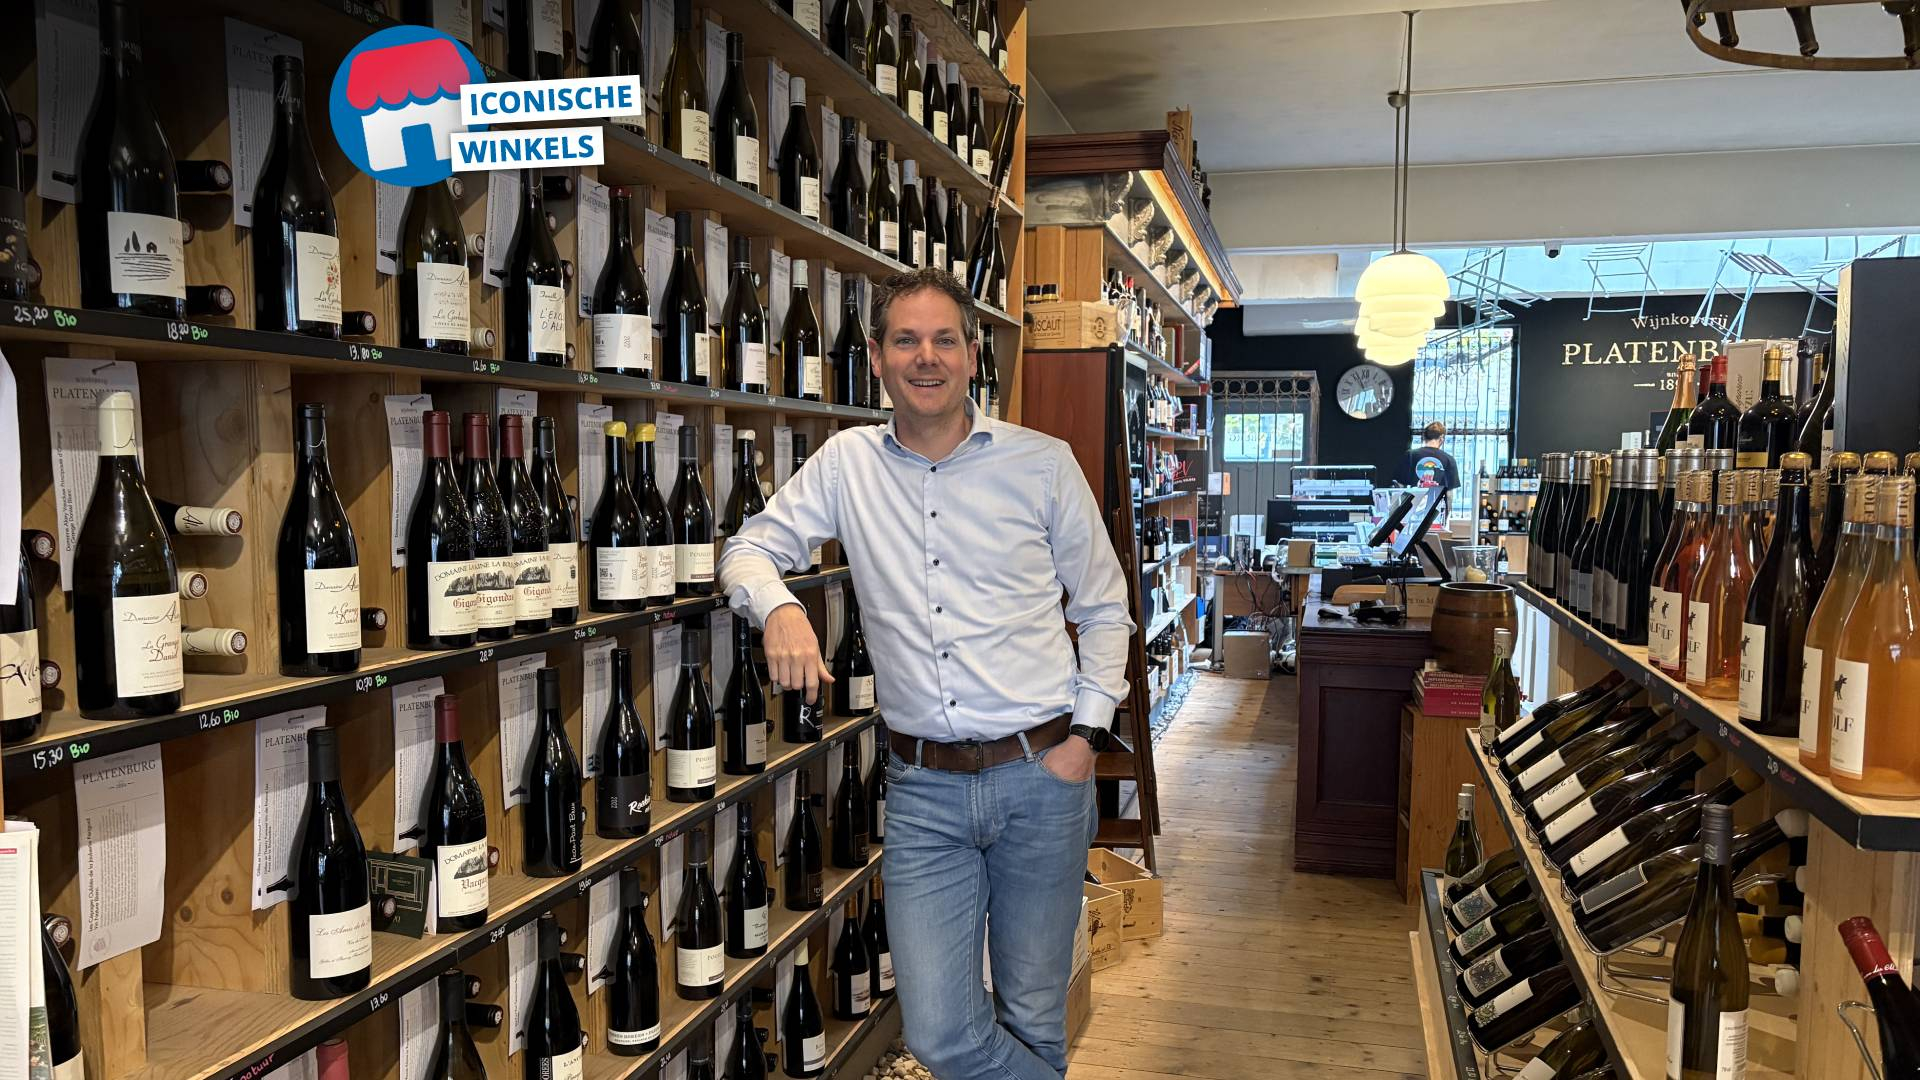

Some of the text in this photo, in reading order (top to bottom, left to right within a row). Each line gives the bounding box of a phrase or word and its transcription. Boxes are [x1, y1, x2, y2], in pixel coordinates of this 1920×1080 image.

[13, 305, 78, 328] 25,20 Bio
[1631, 313, 1730, 330] Wijnkoperij
[166, 322, 208, 341] 18,20 Bio
[348, 344, 383, 361] 13,80 Bio
[489, 362, 501, 374] Bio
[375, 674, 388, 688] Bio
[501, 671, 539, 687] PLATENBUR
[399, 700, 436, 712] PLATENBU
[199, 709, 240, 730] 12,60 Bio
[265, 734, 308, 748] PLATENBU
[33, 747, 64, 771] 15,30
[69, 743, 90, 760] Bio
[82, 759, 157, 785] PLATENBURG
[569, 822, 582, 864] Jean-Paul
[444, 845, 477, 865] DOMAINE
